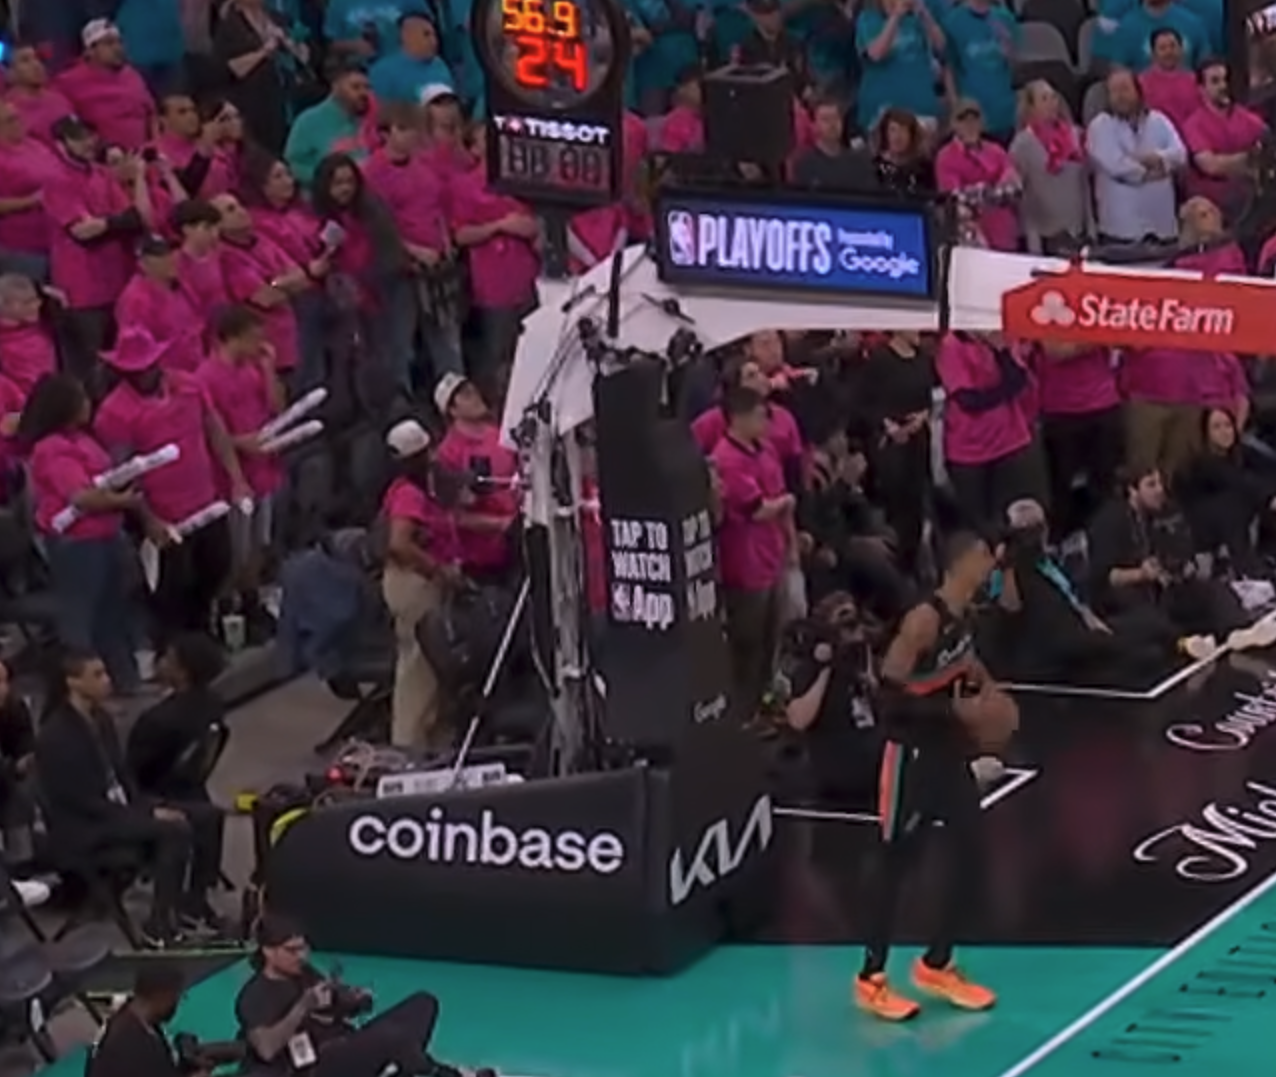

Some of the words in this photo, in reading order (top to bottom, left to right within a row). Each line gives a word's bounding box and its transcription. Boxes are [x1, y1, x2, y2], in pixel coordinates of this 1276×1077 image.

[515, 34, 590, 93] 24
[698, 213, 832, 275] PLAYOFFS
[839, 247, 920, 279] Google
[611, 519, 643, 548] TAP
[644, 521, 668, 551] TO
[611, 550, 671, 583] WATCH
[632, 584, 674, 630] App
[349, 807, 625, 874] coinbase
